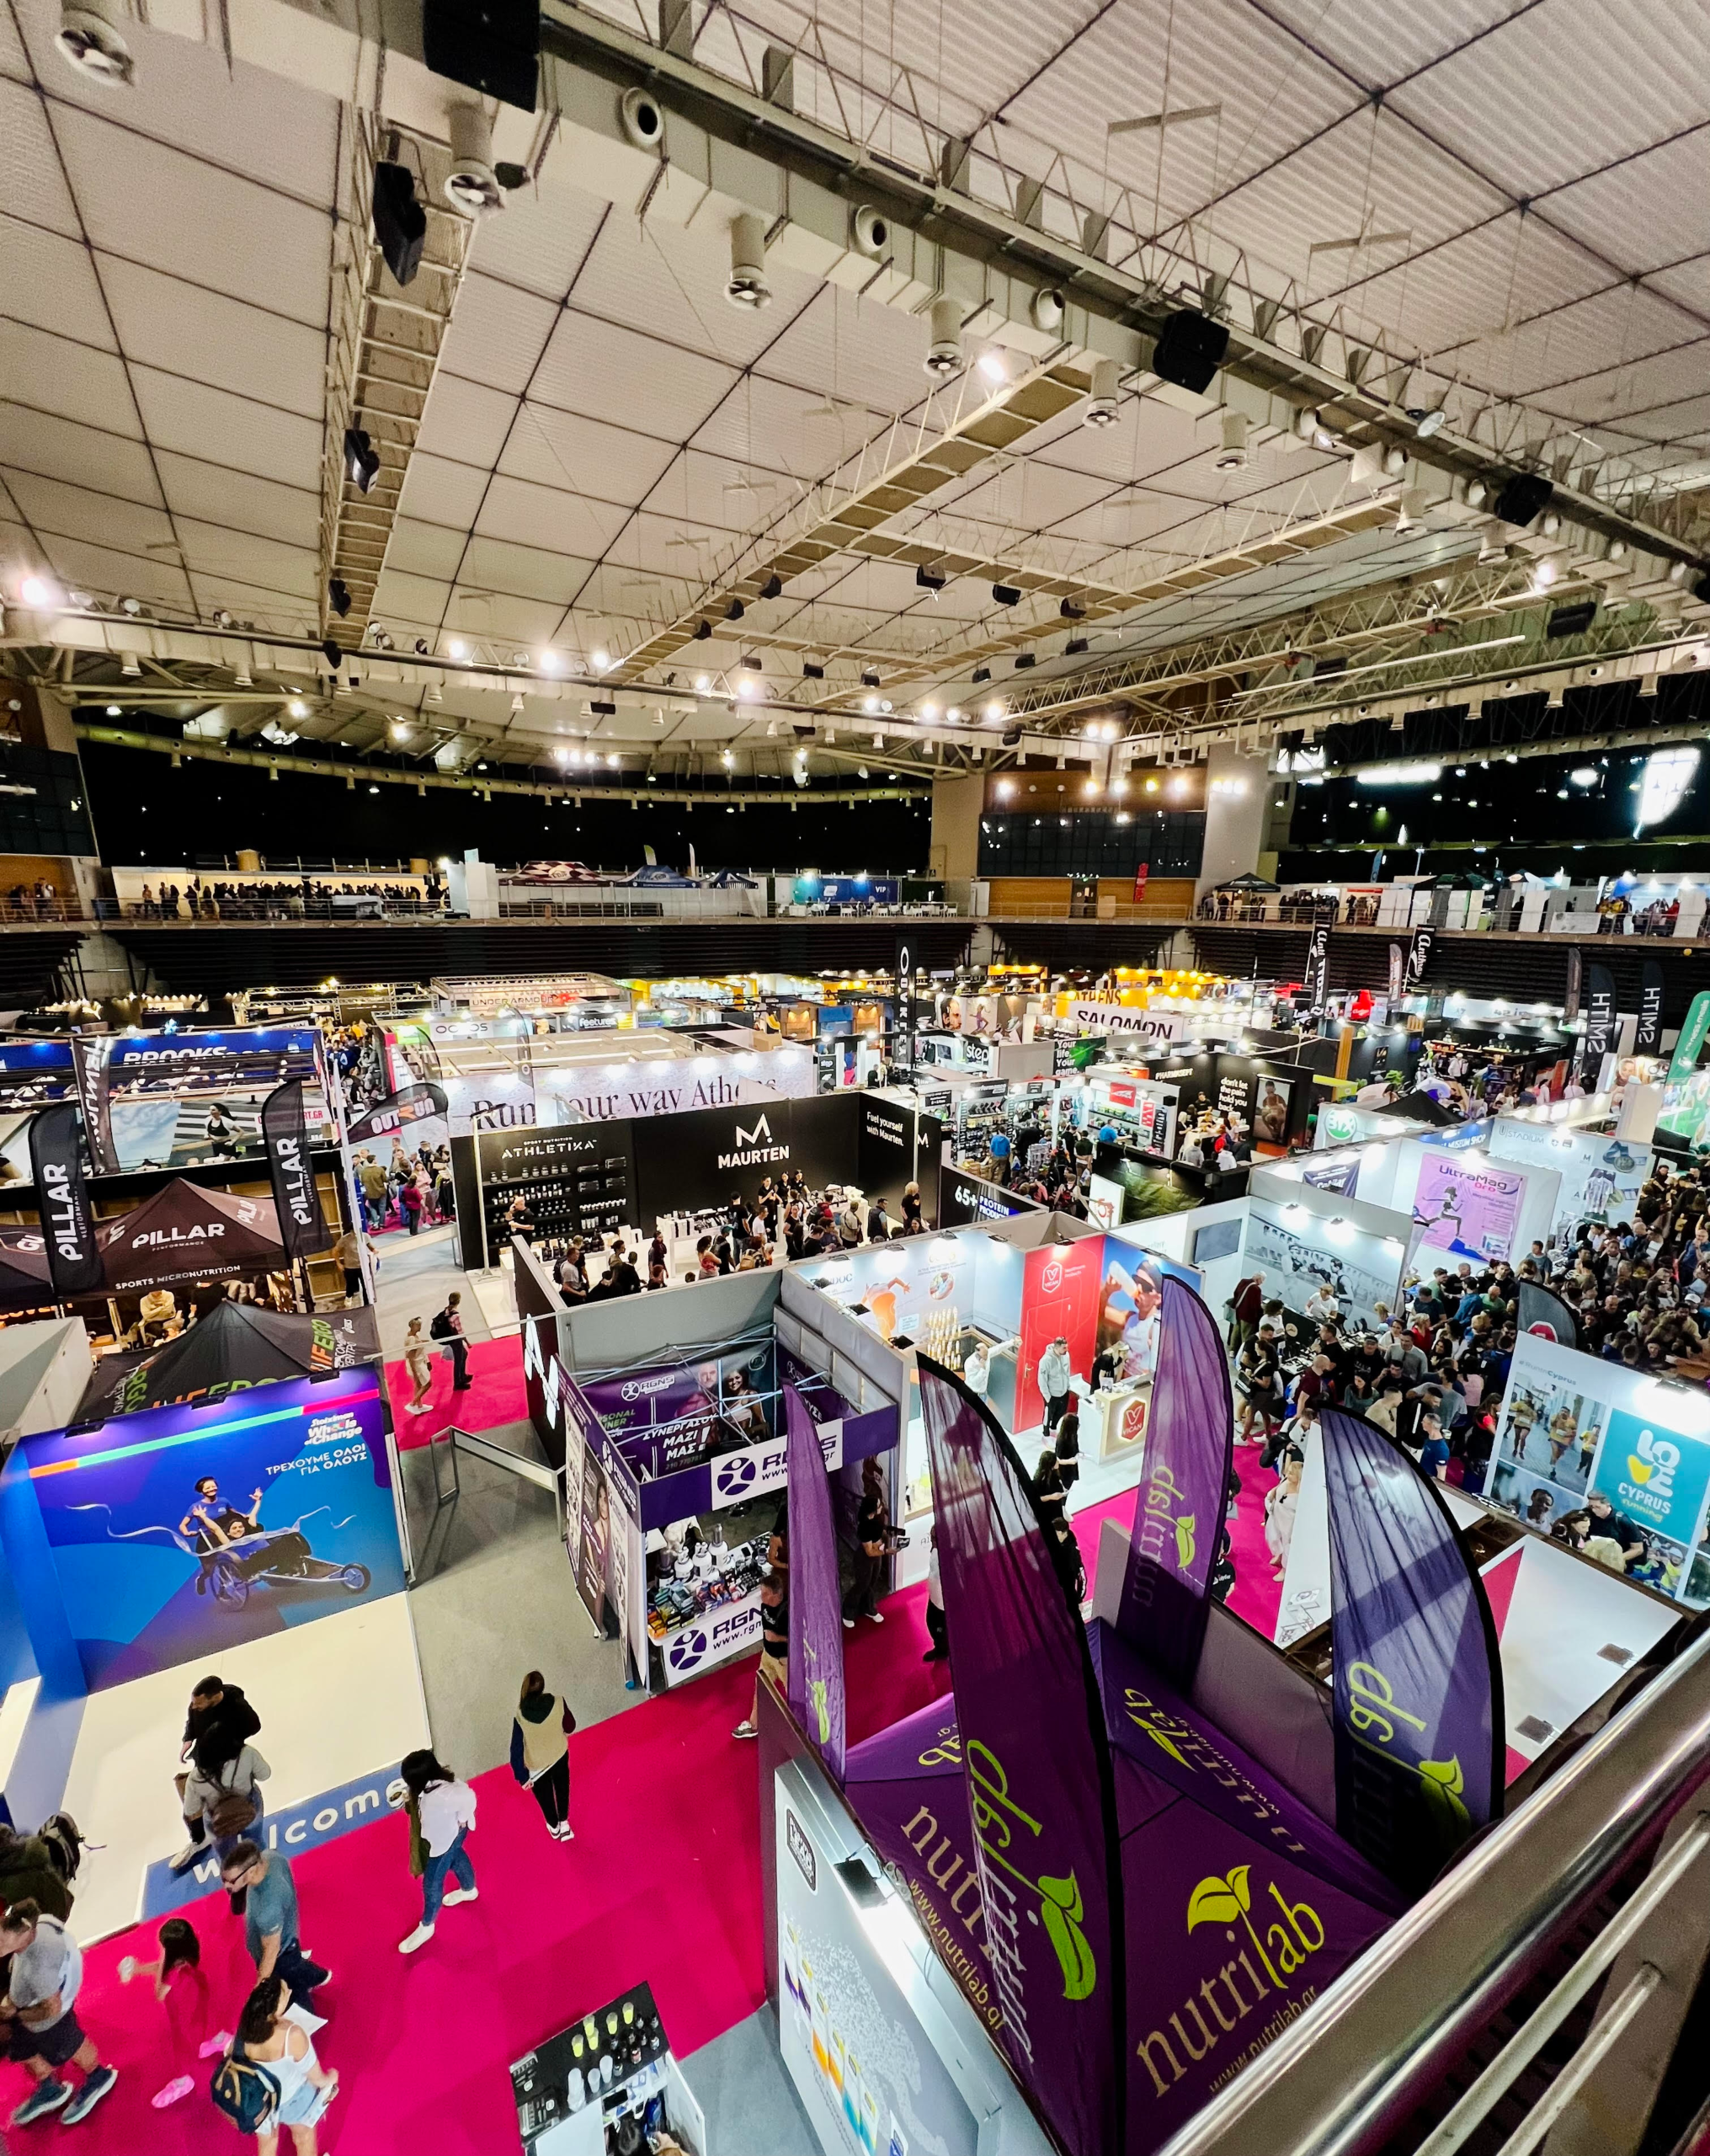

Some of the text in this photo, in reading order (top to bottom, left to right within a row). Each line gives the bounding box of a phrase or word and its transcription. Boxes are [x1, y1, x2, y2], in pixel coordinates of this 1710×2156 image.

[510, 995, 555, 1005] ARMOUR
[1077, 1010, 1174, 1039] SALOMON
[124, 1046, 227, 1065] BROOKS
[967, 1043, 989, 1065] step
[1057, 1040, 1076, 1049] Your
[1057, 1050, 1072, 1059] life.
[1056, 1065, 1079, 1076] game.
[1057, 1058, 1076, 1068] Your
[1220, 1085, 1246, 1097] the pain
[1239, 1081, 1248, 1090] let
[473, 1100, 535, 1129] Run
[629, 1088, 683, 1113] way
[1219, 1093, 1248, 1107] hold you
[866, 1112, 903, 1133] Fuel yourself
[866, 1125, 904, 1147] with Maurten.
[1471, 1134, 1487, 1145] SHOP
[1508, 1130, 1545, 1145] STADIUM
[717, 1145, 790, 1170] MAURTEN
[277, 1137, 312, 1225] PILLAR
[1439, 1164, 1507, 1191] UltraMag
[955, 1184, 1009, 1217] 65+ PROTEIN
[43, 1164, 83, 1262] PILLAR
[131, 1223, 226, 1250] PILLAR
[115, 1265, 242, 1290] SPORTS MICRONUTRITION
[1044, 1279, 1059, 1289] VICAN
[640, 1375, 675, 1393] RGNS
[307, 1418, 357, 1438] Wheels
[311, 1412, 354, 1428] Stoiximan
[1122, 1422, 1143, 1436] VICAN
[312, 1426, 363, 1446] Change
[663, 1432, 700, 1449] ΜΑΖΙ
[265, 1443, 367, 1476] ΤΡΕΧΟΥΜΕ ΟΛΟΙ
[301, 1452, 368, 1476] ΓΙΑ ΟΛΟΥΣ
[1617, 1481, 1672, 1515] CYPRUS
[1621, 1497, 1664, 1523] running
[712, 1604, 763, 1640] RGN
[1171, 1714, 1281, 1816] www.nutrilab.gr
[192, 1775, 408, 1886] wlcome
[909, 1878, 1007, 2031] www.nutrilab.gr
[1136, 1881, 1326, 2099] nutrilab
